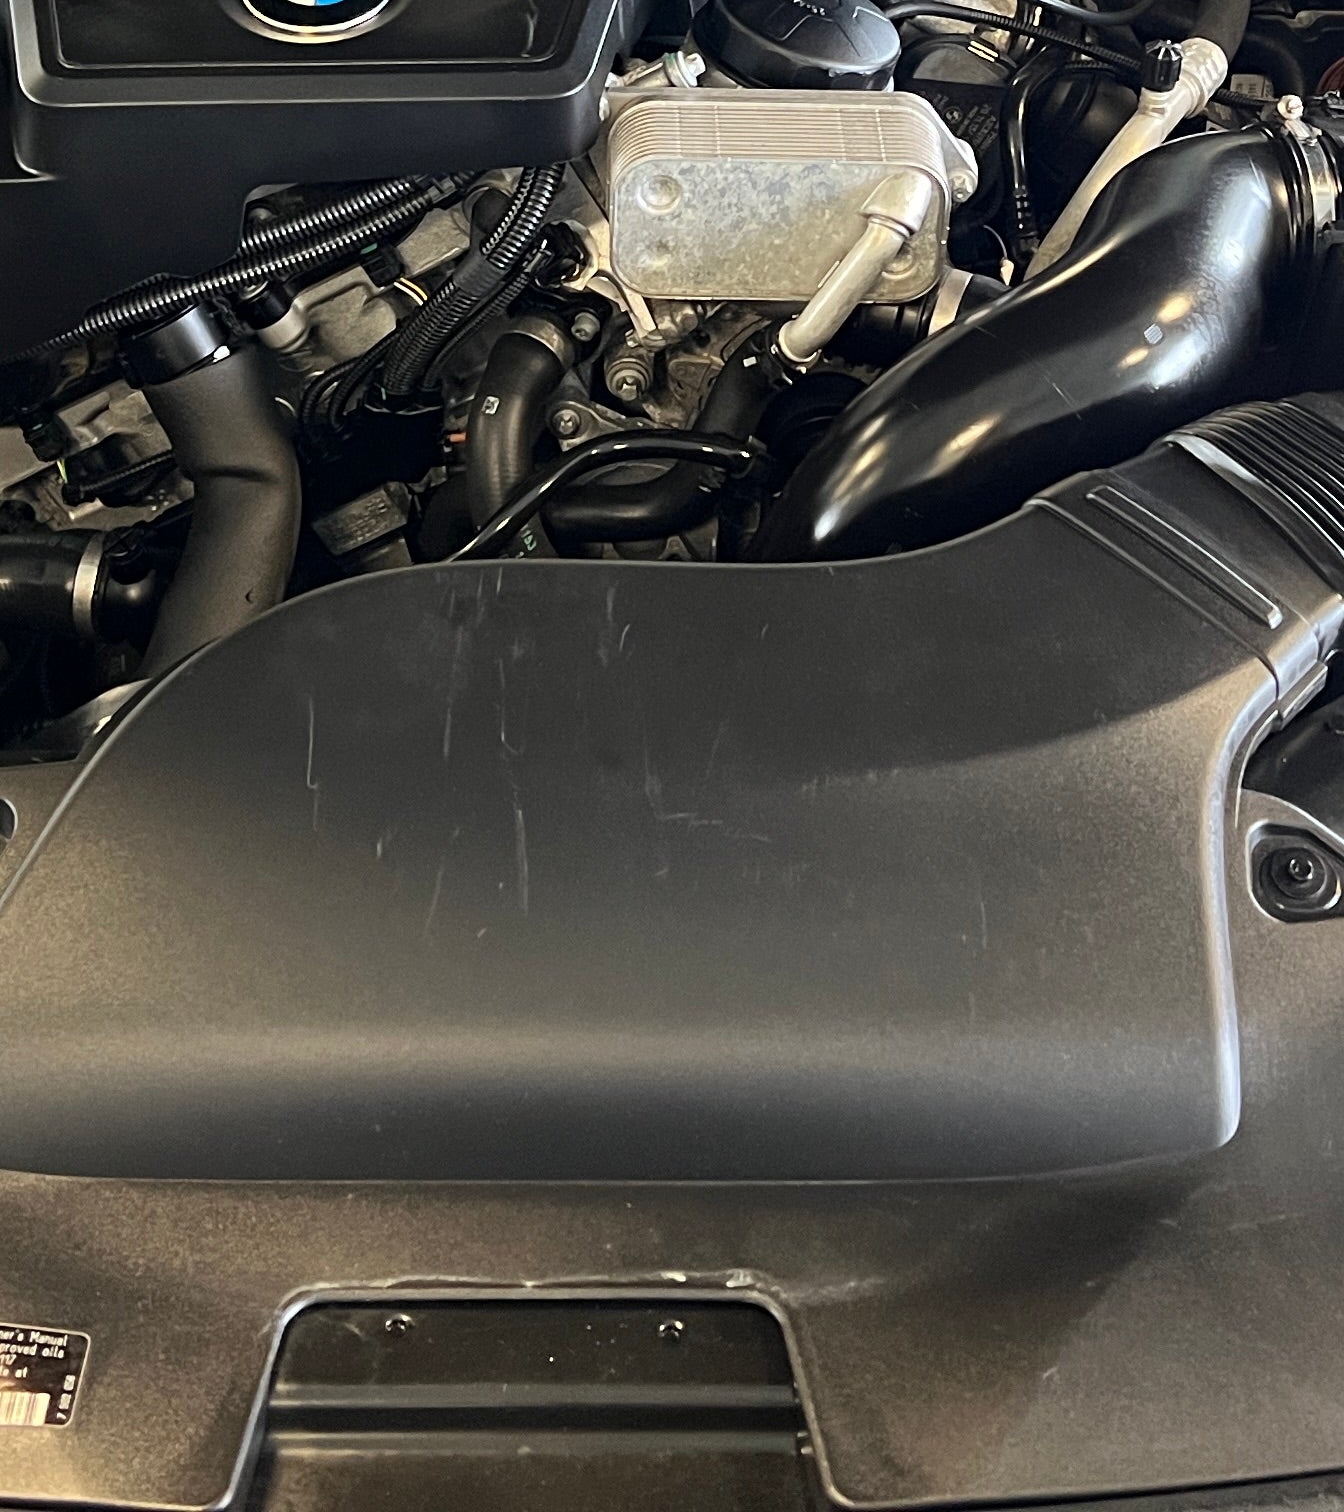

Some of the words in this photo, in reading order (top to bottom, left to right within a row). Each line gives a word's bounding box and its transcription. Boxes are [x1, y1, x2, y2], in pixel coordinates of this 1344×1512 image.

[29, 1331, 68, 1347] Manual
[41, 1345, 65, 1359] oils
[15, 1366, 28, 1378] at
